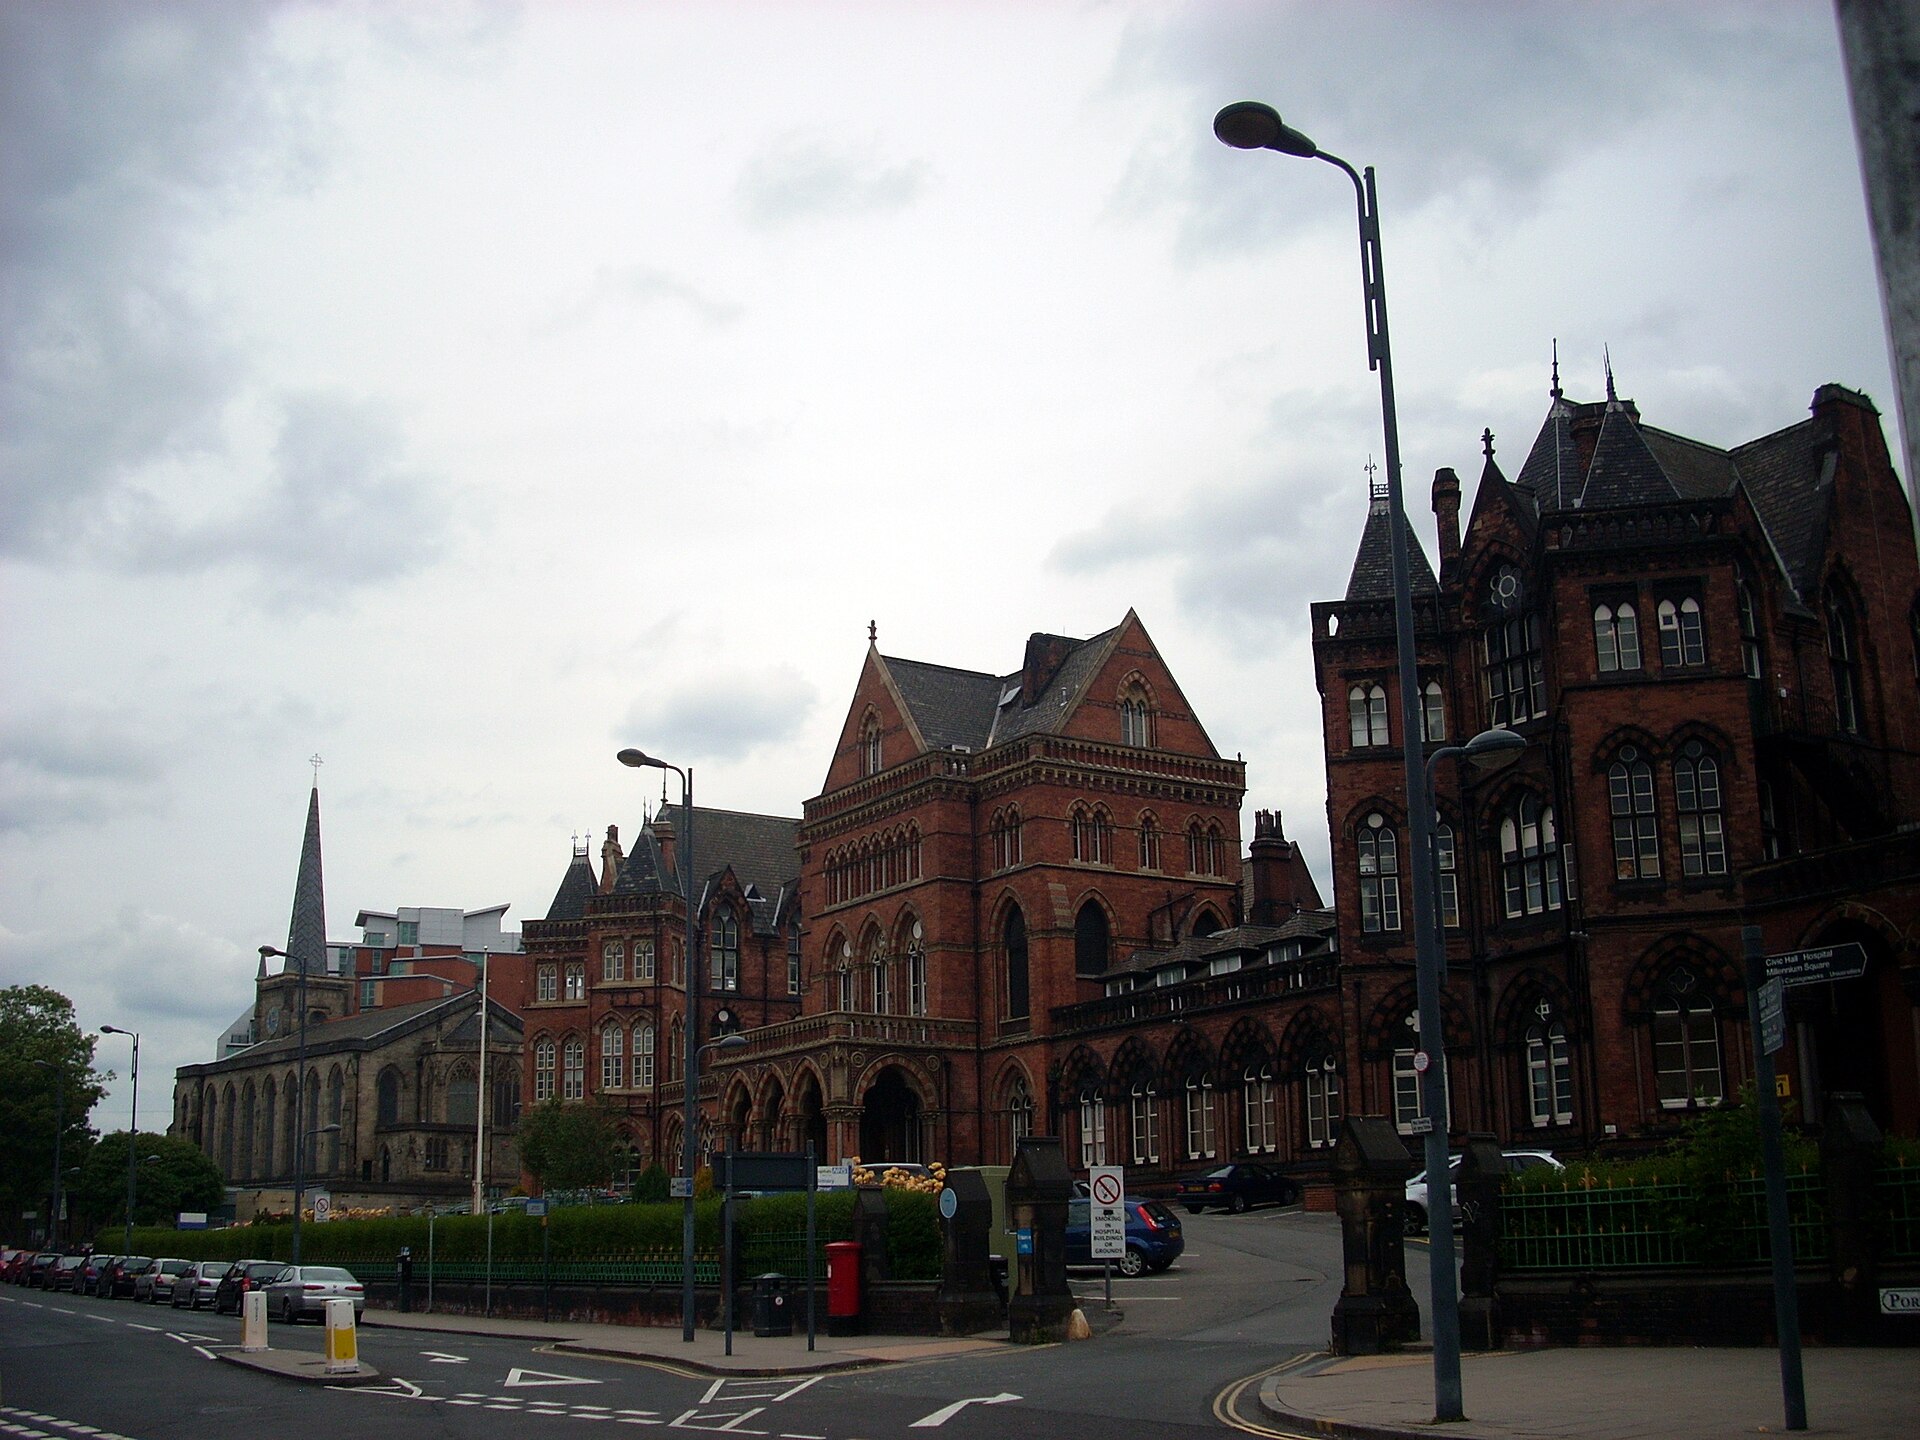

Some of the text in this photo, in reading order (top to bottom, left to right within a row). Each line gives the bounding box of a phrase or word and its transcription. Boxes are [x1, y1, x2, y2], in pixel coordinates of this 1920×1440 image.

[1765, 950, 1832, 967] Civic Hall Hospital
[1766, 961, 1830, 976] Millennium Square
